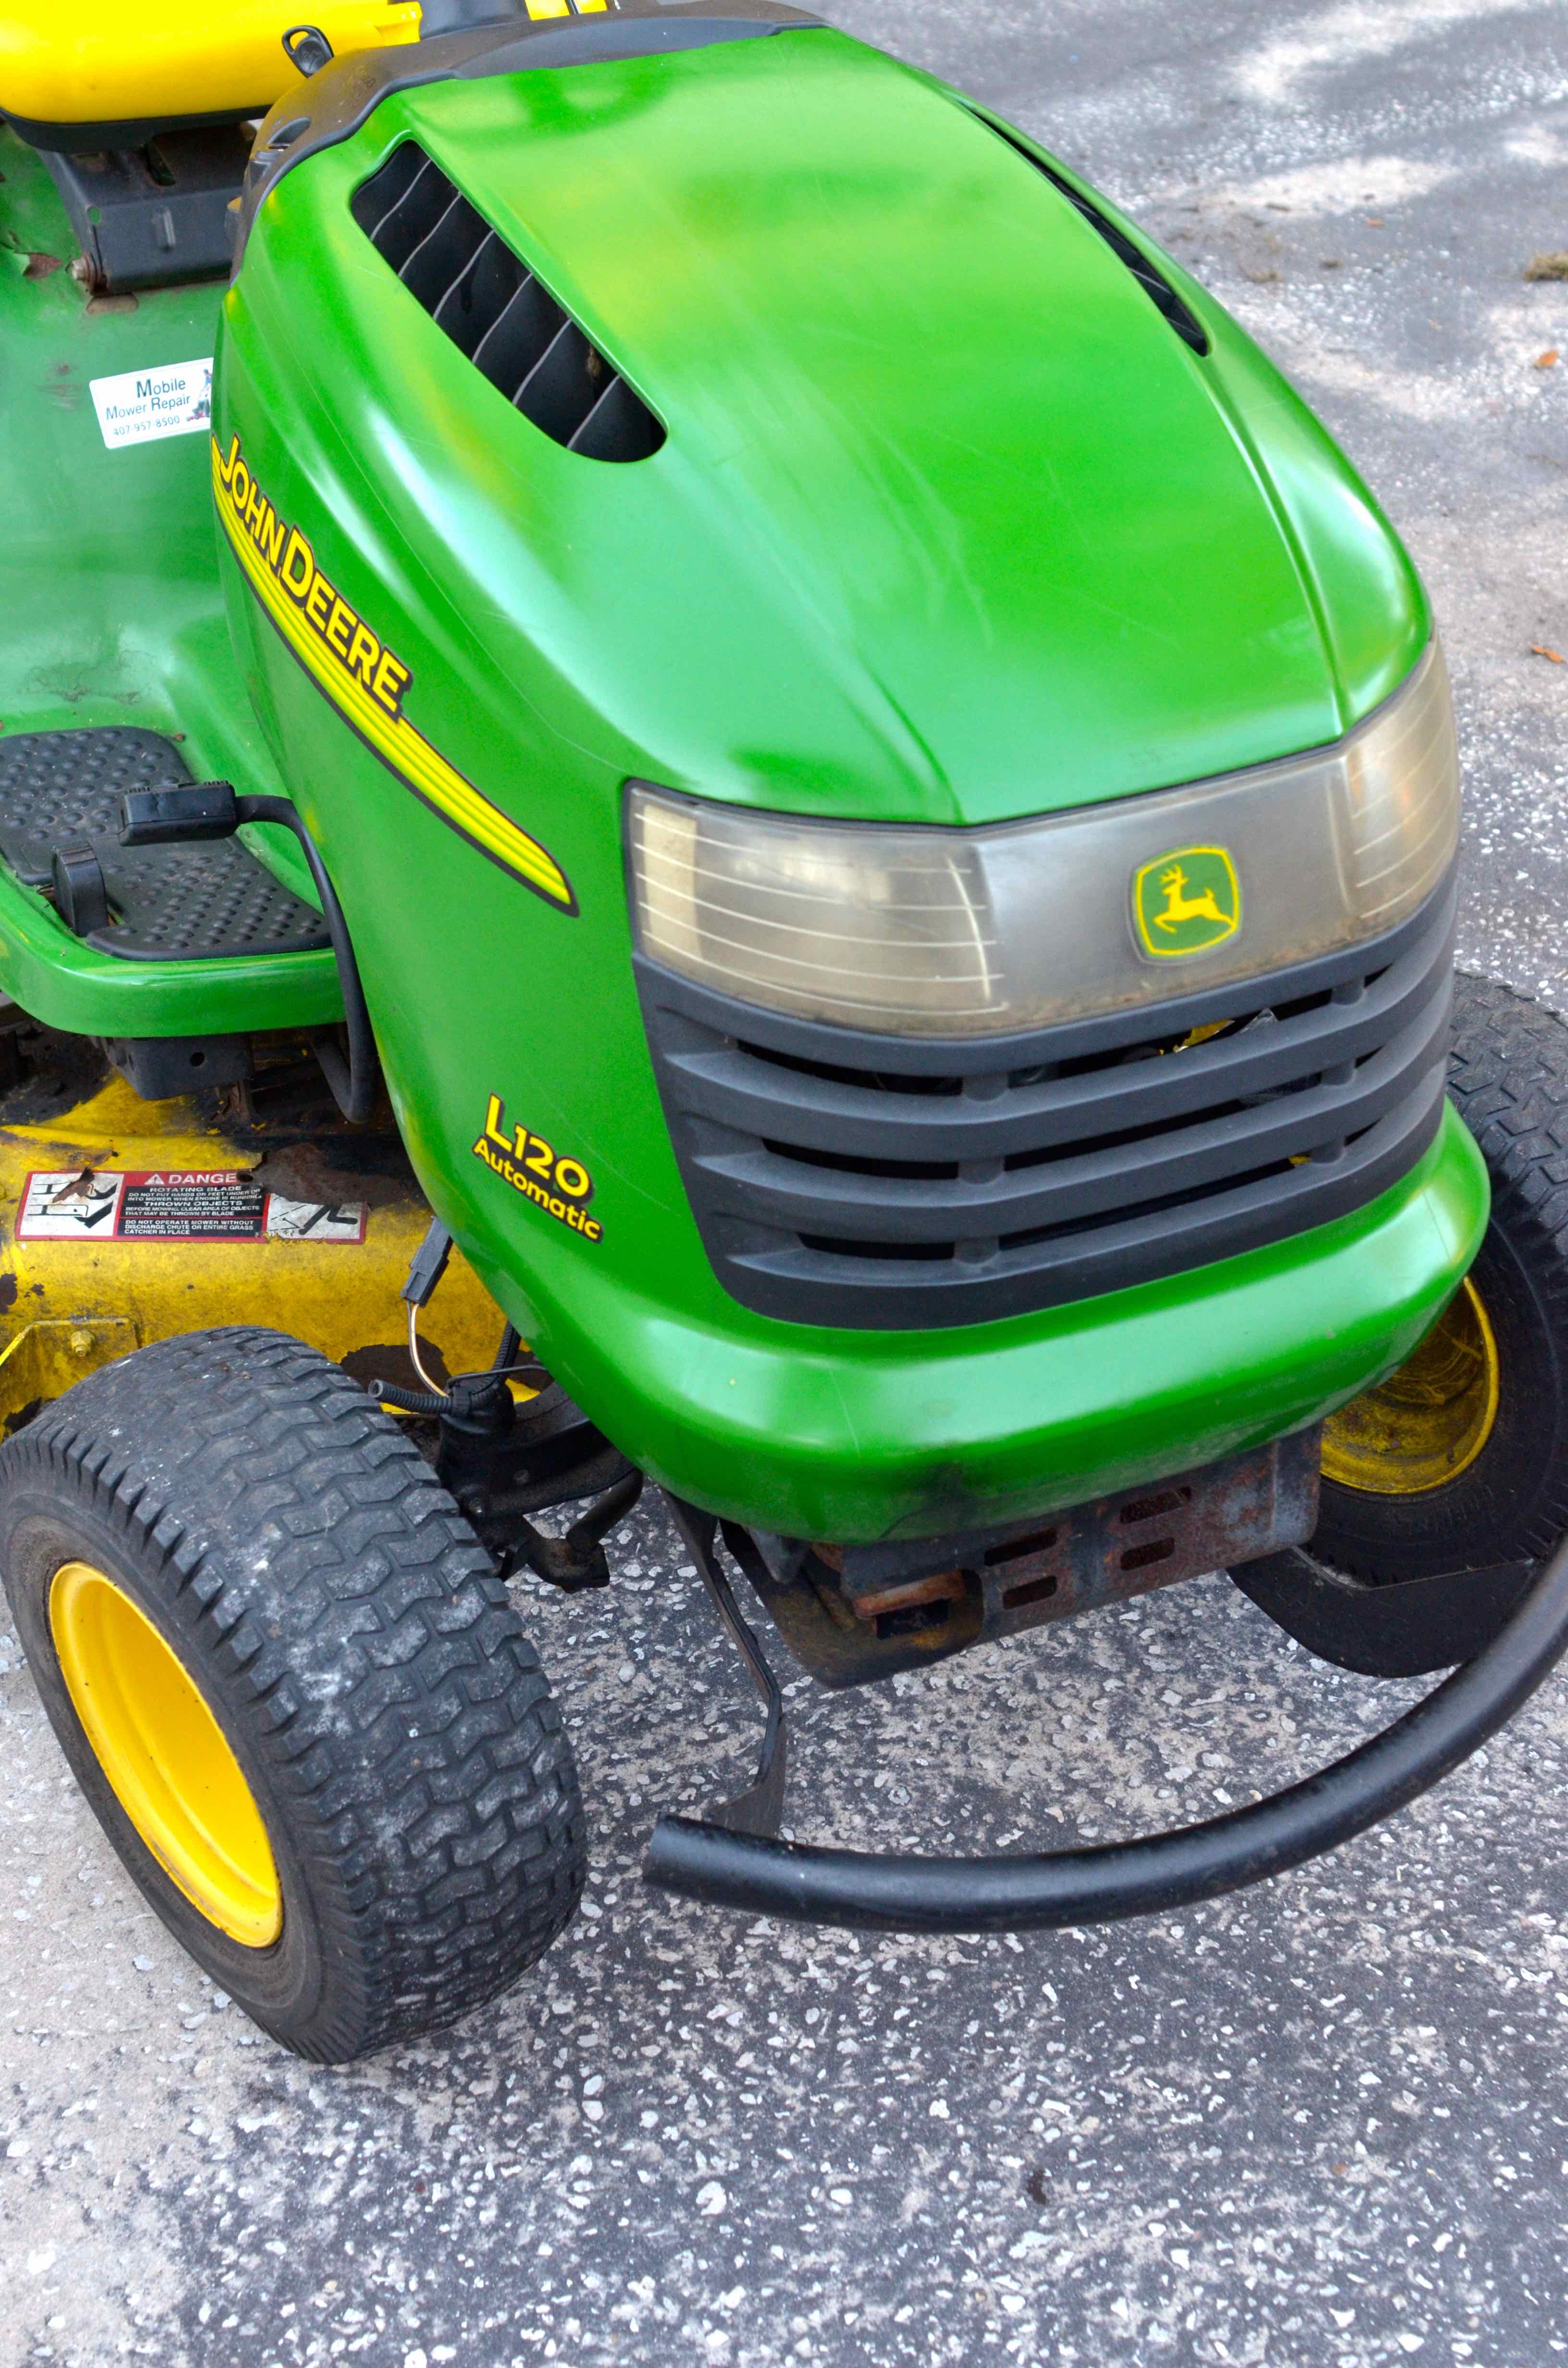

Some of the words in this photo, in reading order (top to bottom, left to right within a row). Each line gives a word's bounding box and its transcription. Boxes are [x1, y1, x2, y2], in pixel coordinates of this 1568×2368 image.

[136, 378, 186, 398] Mobile
[106, 404, 147, 420] Mower
[151, 394, 190, 411] Repair
[484, 1093, 591, 1198] L120
[169, 1173, 237, 1184] DANGE
[473, 1136, 601, 1240] Automatic
